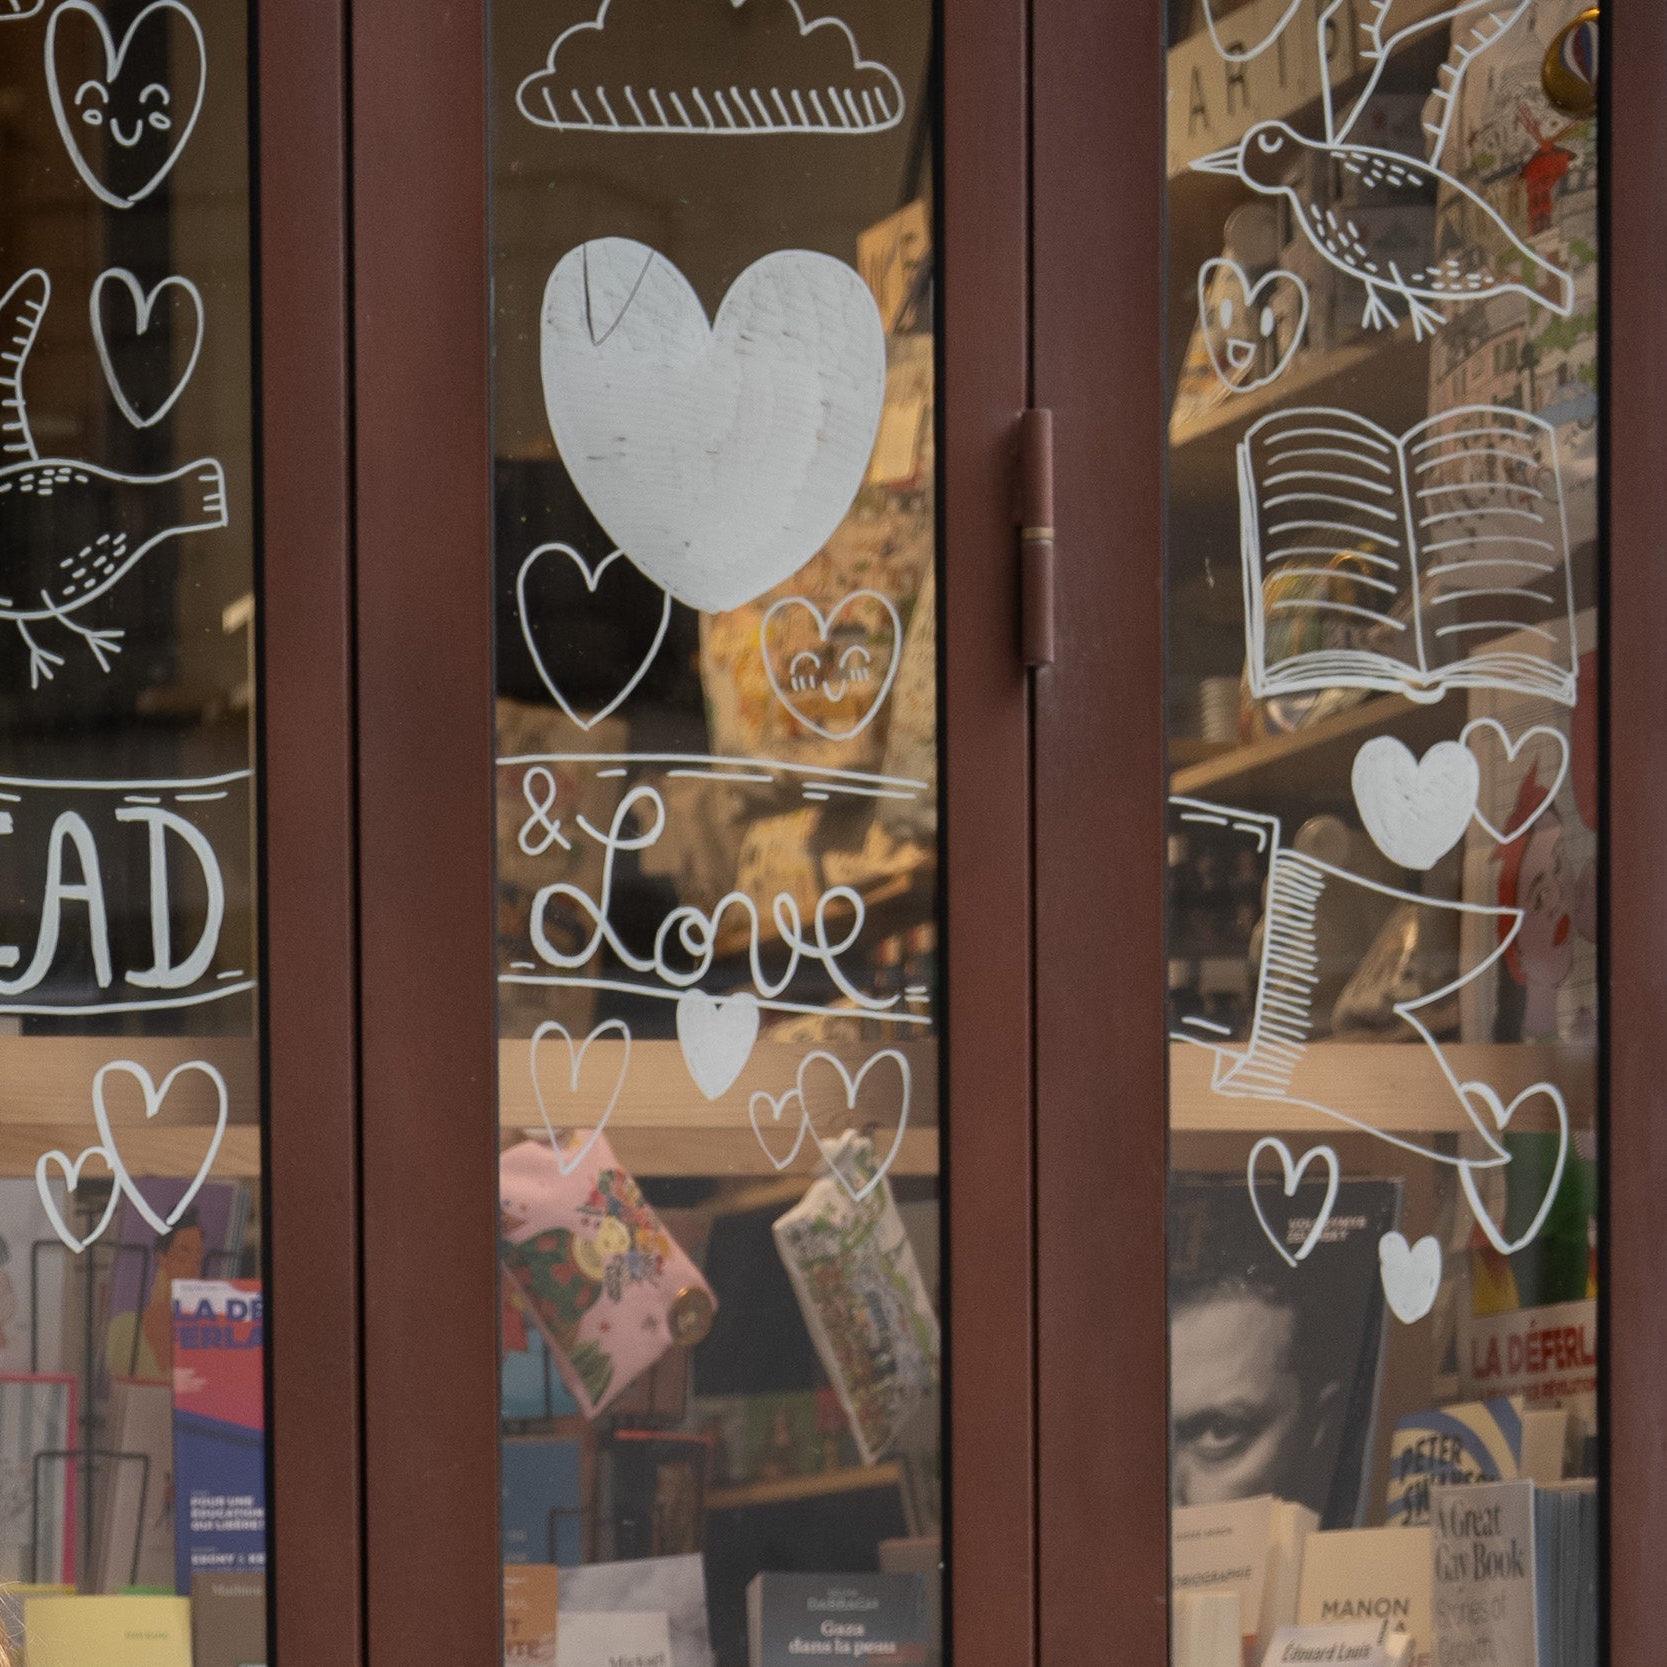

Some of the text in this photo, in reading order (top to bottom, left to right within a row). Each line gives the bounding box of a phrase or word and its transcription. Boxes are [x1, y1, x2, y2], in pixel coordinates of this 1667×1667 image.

[518, 766, 572, 857] &
[529, 786, 904, 1010] Love
[1471, 1334, 1503, 1380] LA
[1399, 1433, 1463, 1481] PETER
[1450, 1503, 1501, 1538] Great
[1472, 1538, 1525, 1583] Book
[1321, 1597, 1410, 1618] MANON
[787, 1636, 897, 1659] dans la peau
[819, 1619, 866, 1638] Gaza
[1337, 1645, 1371, 1662] Louis
